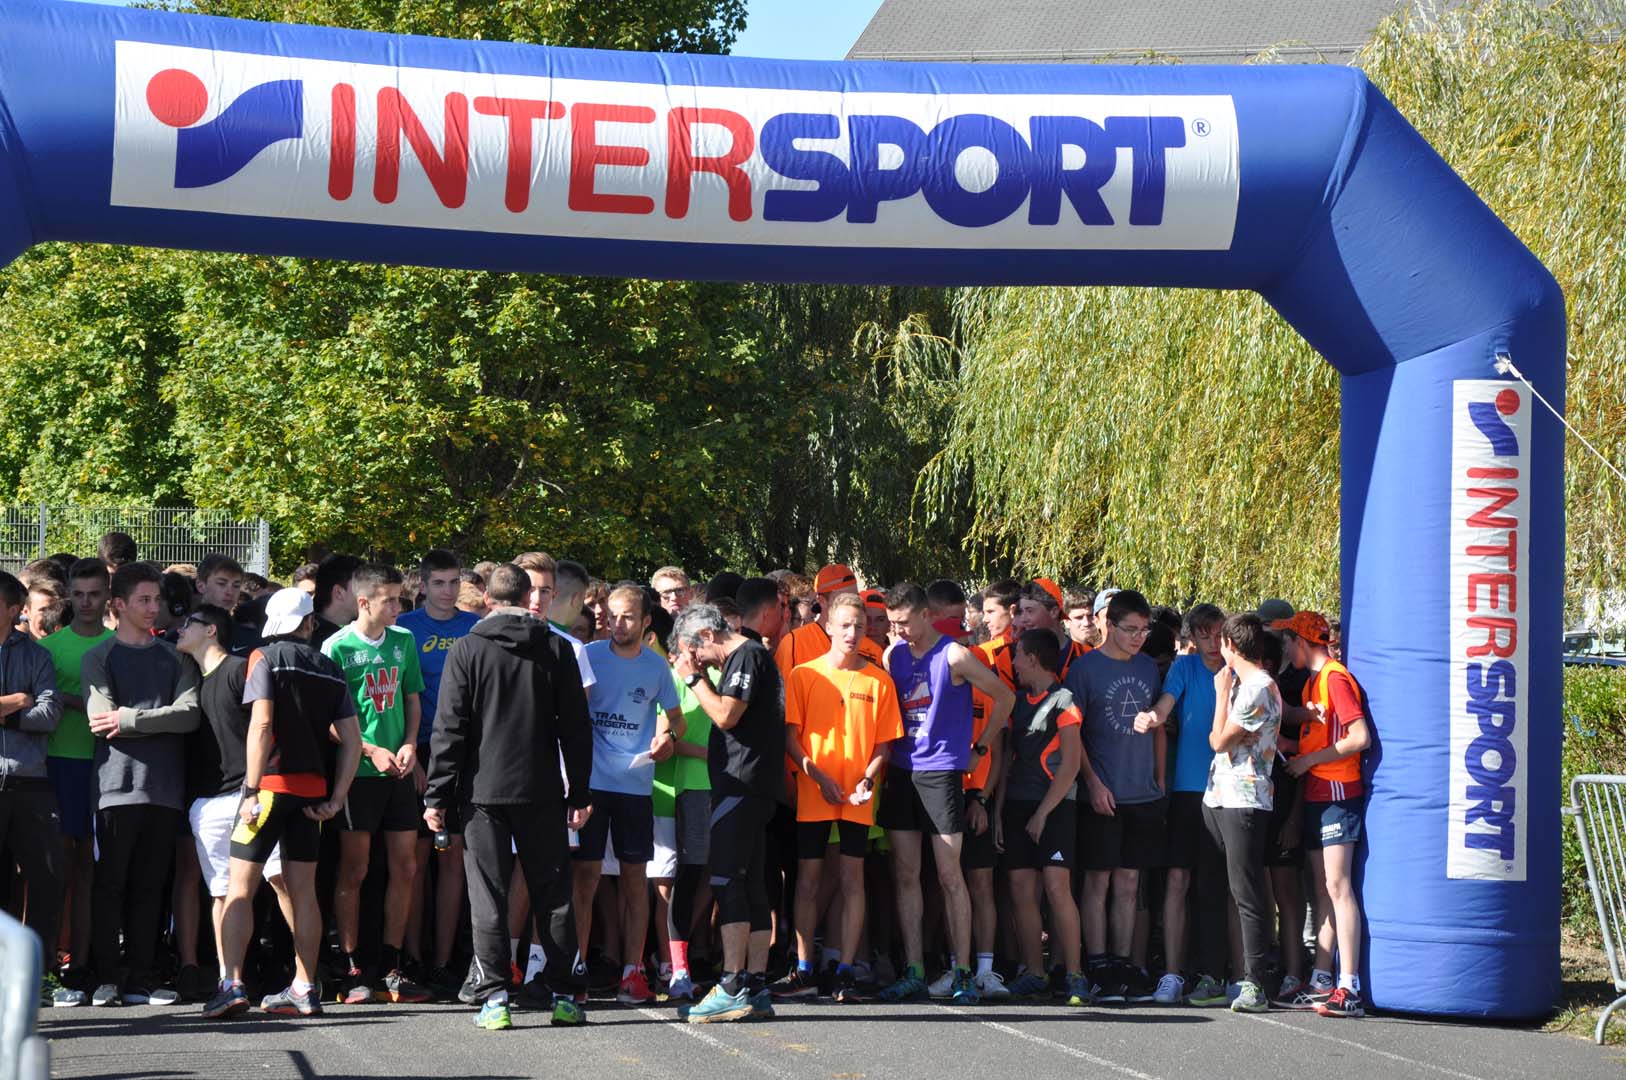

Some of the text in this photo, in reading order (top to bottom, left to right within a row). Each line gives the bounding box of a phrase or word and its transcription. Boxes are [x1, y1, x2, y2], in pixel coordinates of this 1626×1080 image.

[328, 82, 1186, 228] INTERSPORT
[1465, 467, 1519, 861] INTERSPORT
[591, 719, 640, 731] ARGERIDE
[593, 711, 627, 722] TRAIL
